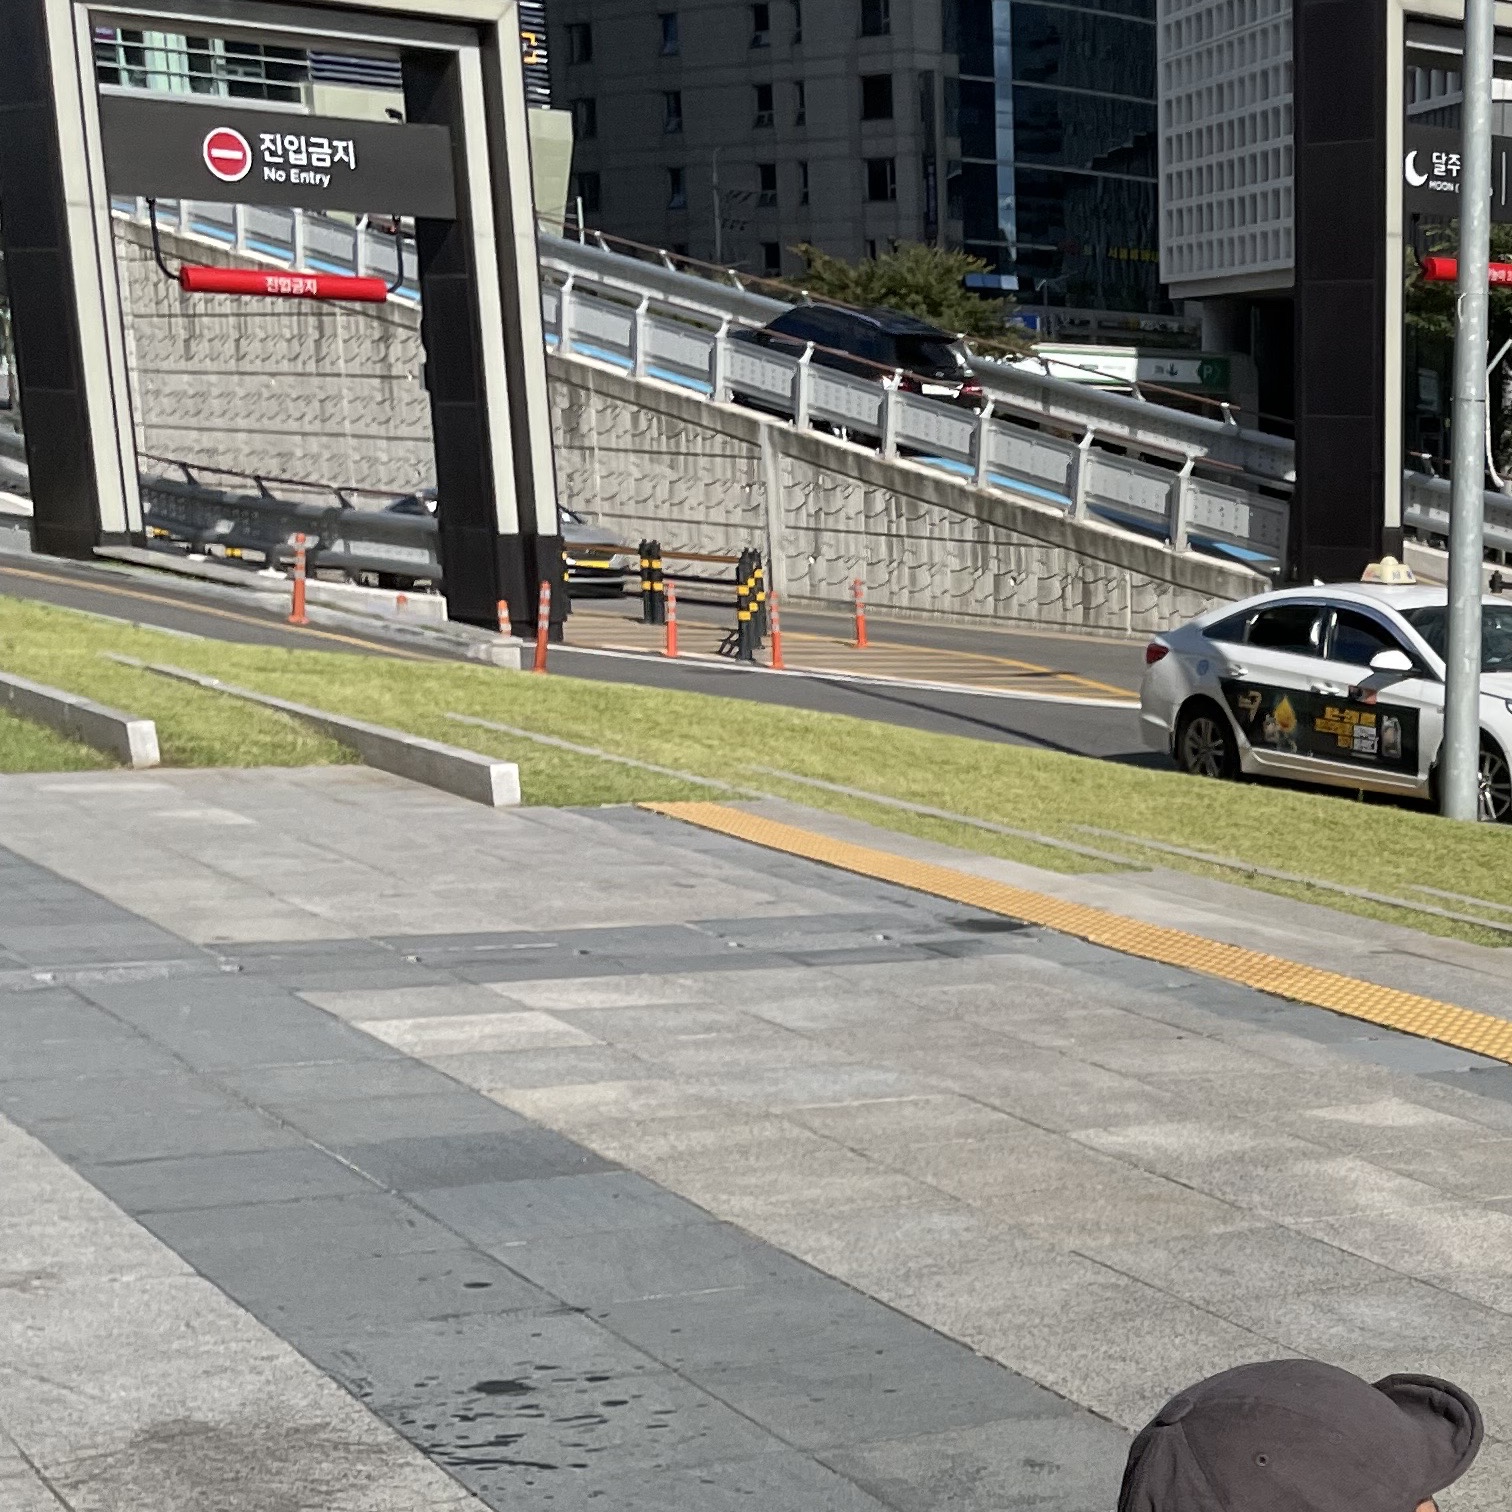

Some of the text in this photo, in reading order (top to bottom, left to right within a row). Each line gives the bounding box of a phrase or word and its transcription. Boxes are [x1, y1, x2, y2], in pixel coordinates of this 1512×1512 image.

[259, 133, 357, 170] 진입금지
[1431, 152, 1462, 177] 달주
[263, 167, 331, 188] No Entry
[1428, 180, 1454, 192] MOON
[265, 275, 318, 294] 진입금지
